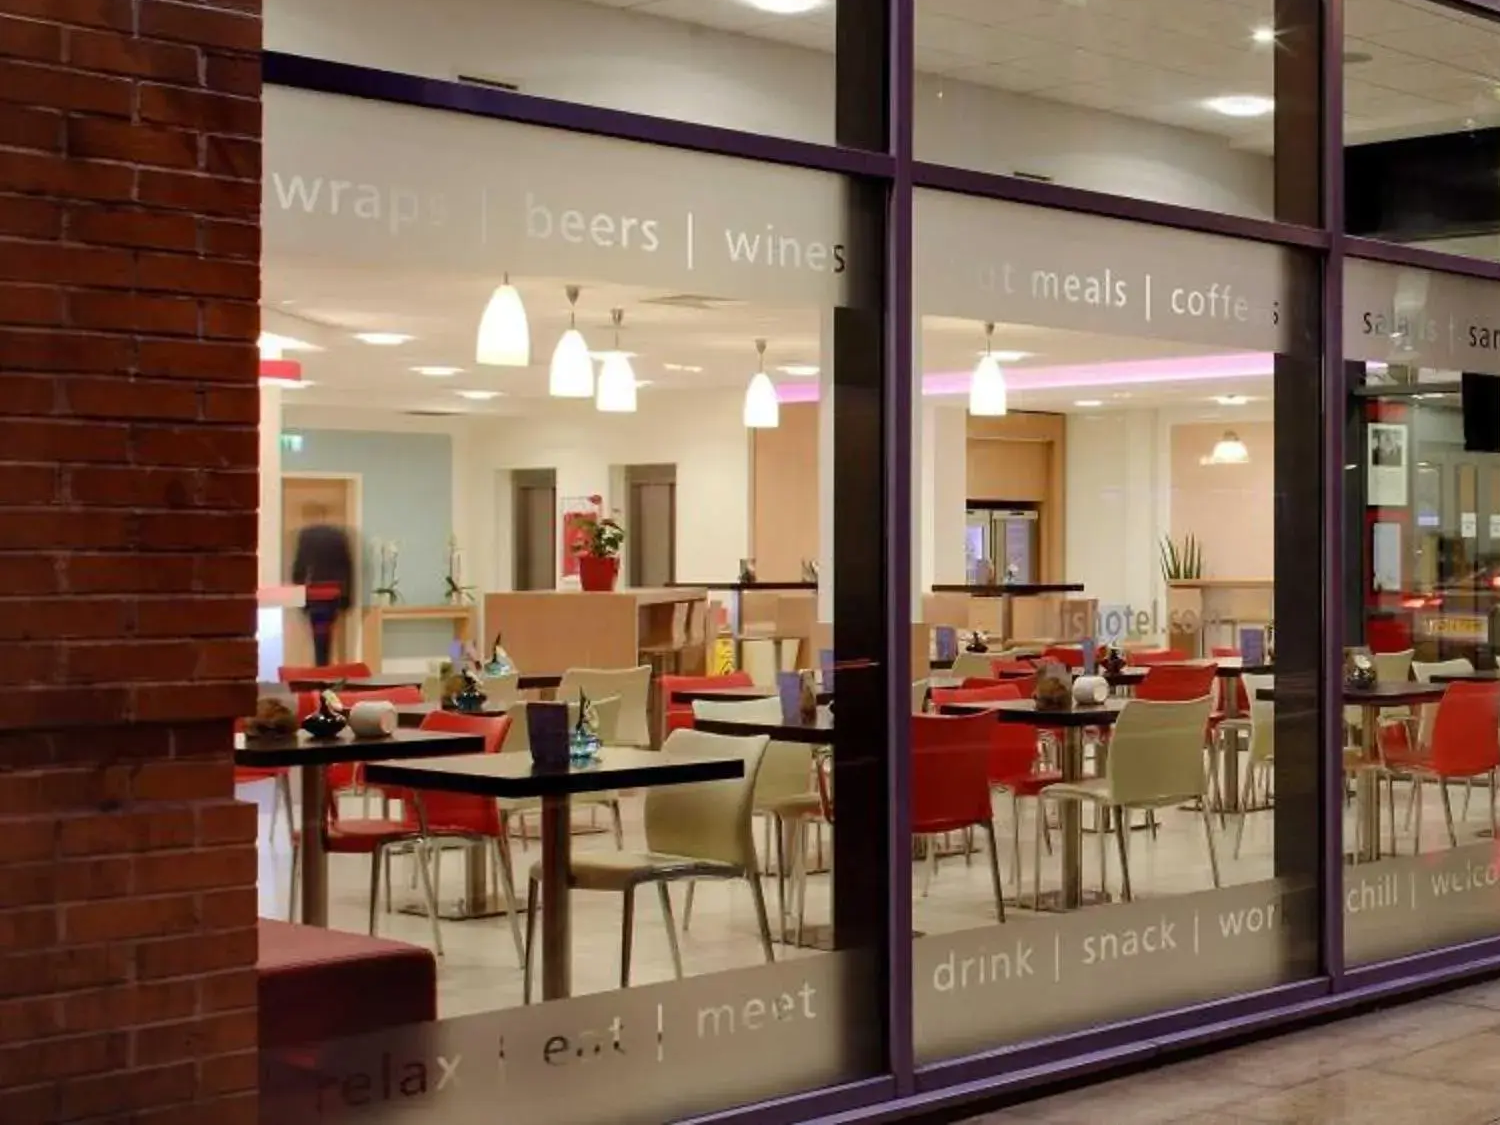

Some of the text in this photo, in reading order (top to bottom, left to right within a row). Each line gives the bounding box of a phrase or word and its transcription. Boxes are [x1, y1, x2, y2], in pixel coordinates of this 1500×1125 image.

[525, 195, 660, 253] beers
[726, 227, 846, 273] wines
[1029, 267, 1129, 309] meals
[1347, 871, 1399, 912] chill
[933, 939, 1035, 992] drink
[1082, 918, 1177, 964] snack
[316, 1052, 462, 1113] relax
[697, 982, 818, 1038] meet
